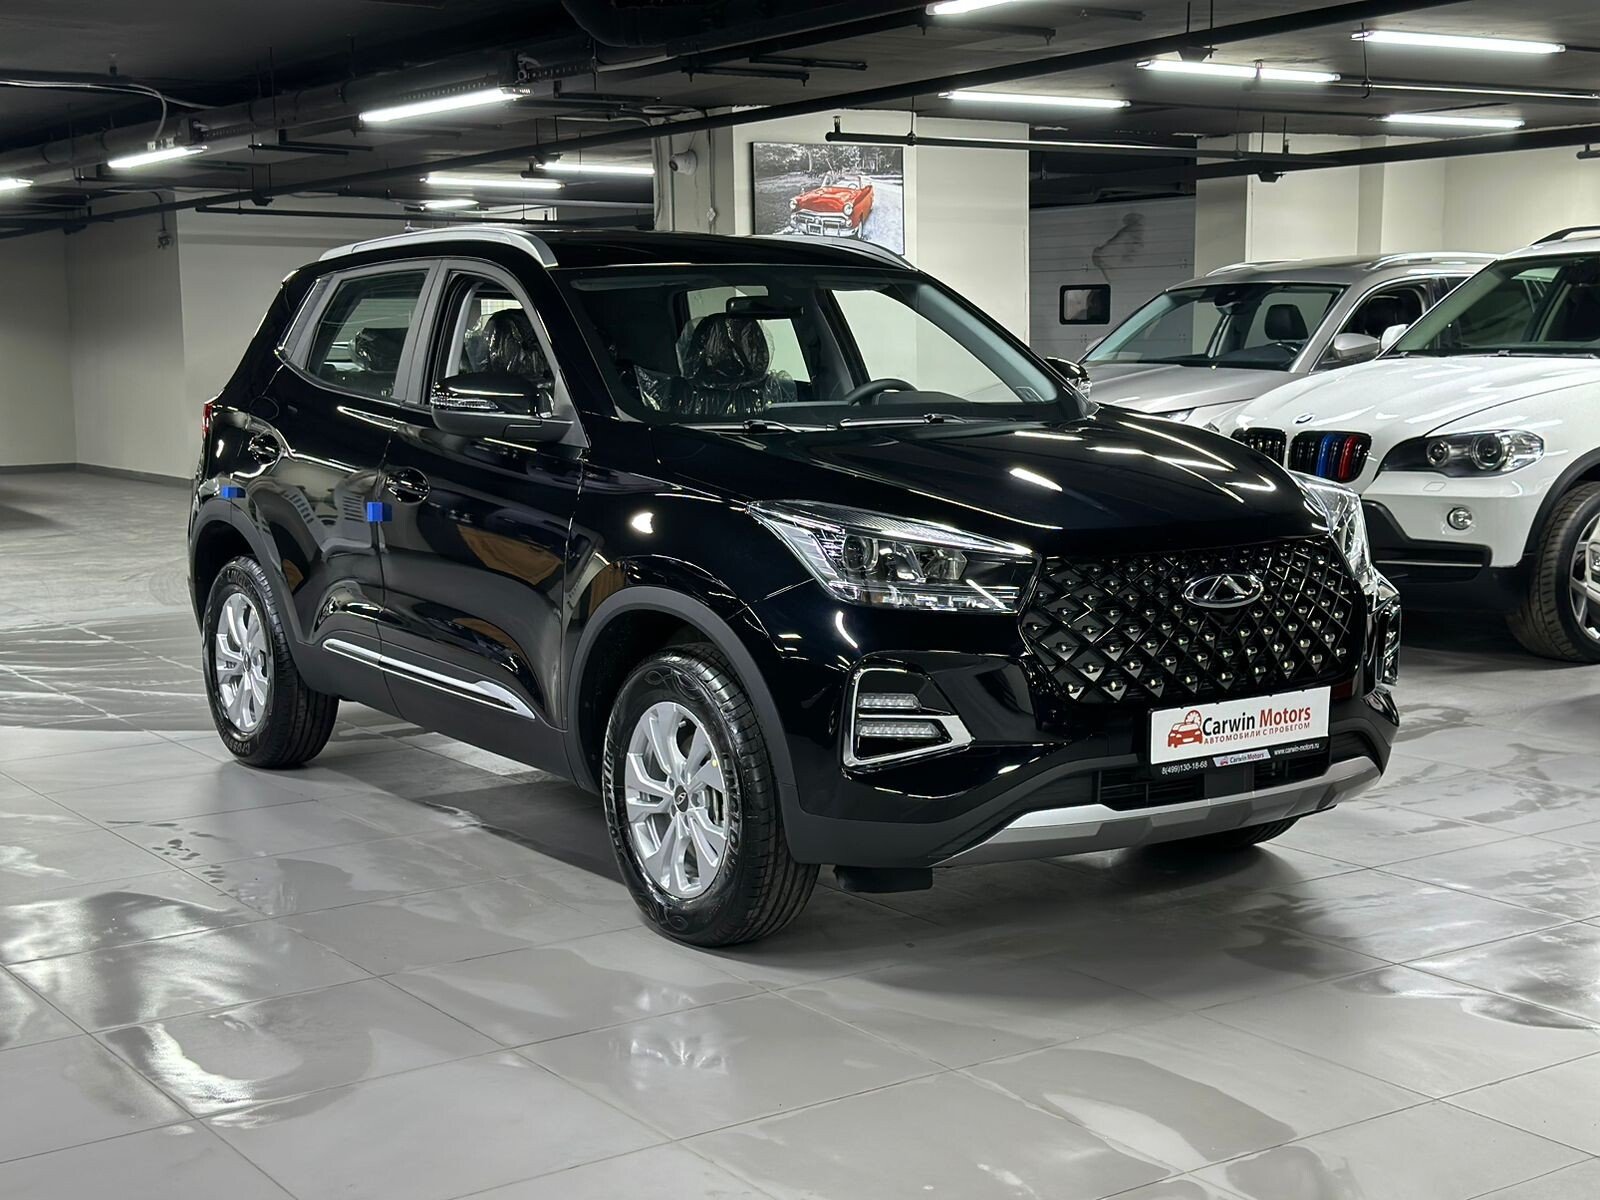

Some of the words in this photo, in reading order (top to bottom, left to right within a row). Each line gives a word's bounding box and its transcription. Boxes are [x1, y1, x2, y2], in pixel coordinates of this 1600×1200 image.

[1203, 712, 1255, 736] Carwin
[1259, 706, 1311, 728] Motors
[1204, 729, 1261, 745] АВТОМОБИЛИ
[1263, 728, 1268, 736] С
[1269, 722, 1311, 735] ПРОБЕГОМ
[1230, 754, 1247, 763] Carwin
[1247, 752, 1265, 761] Motors
[1274, 743, 1320, 756] www.carwin-motors.ru
